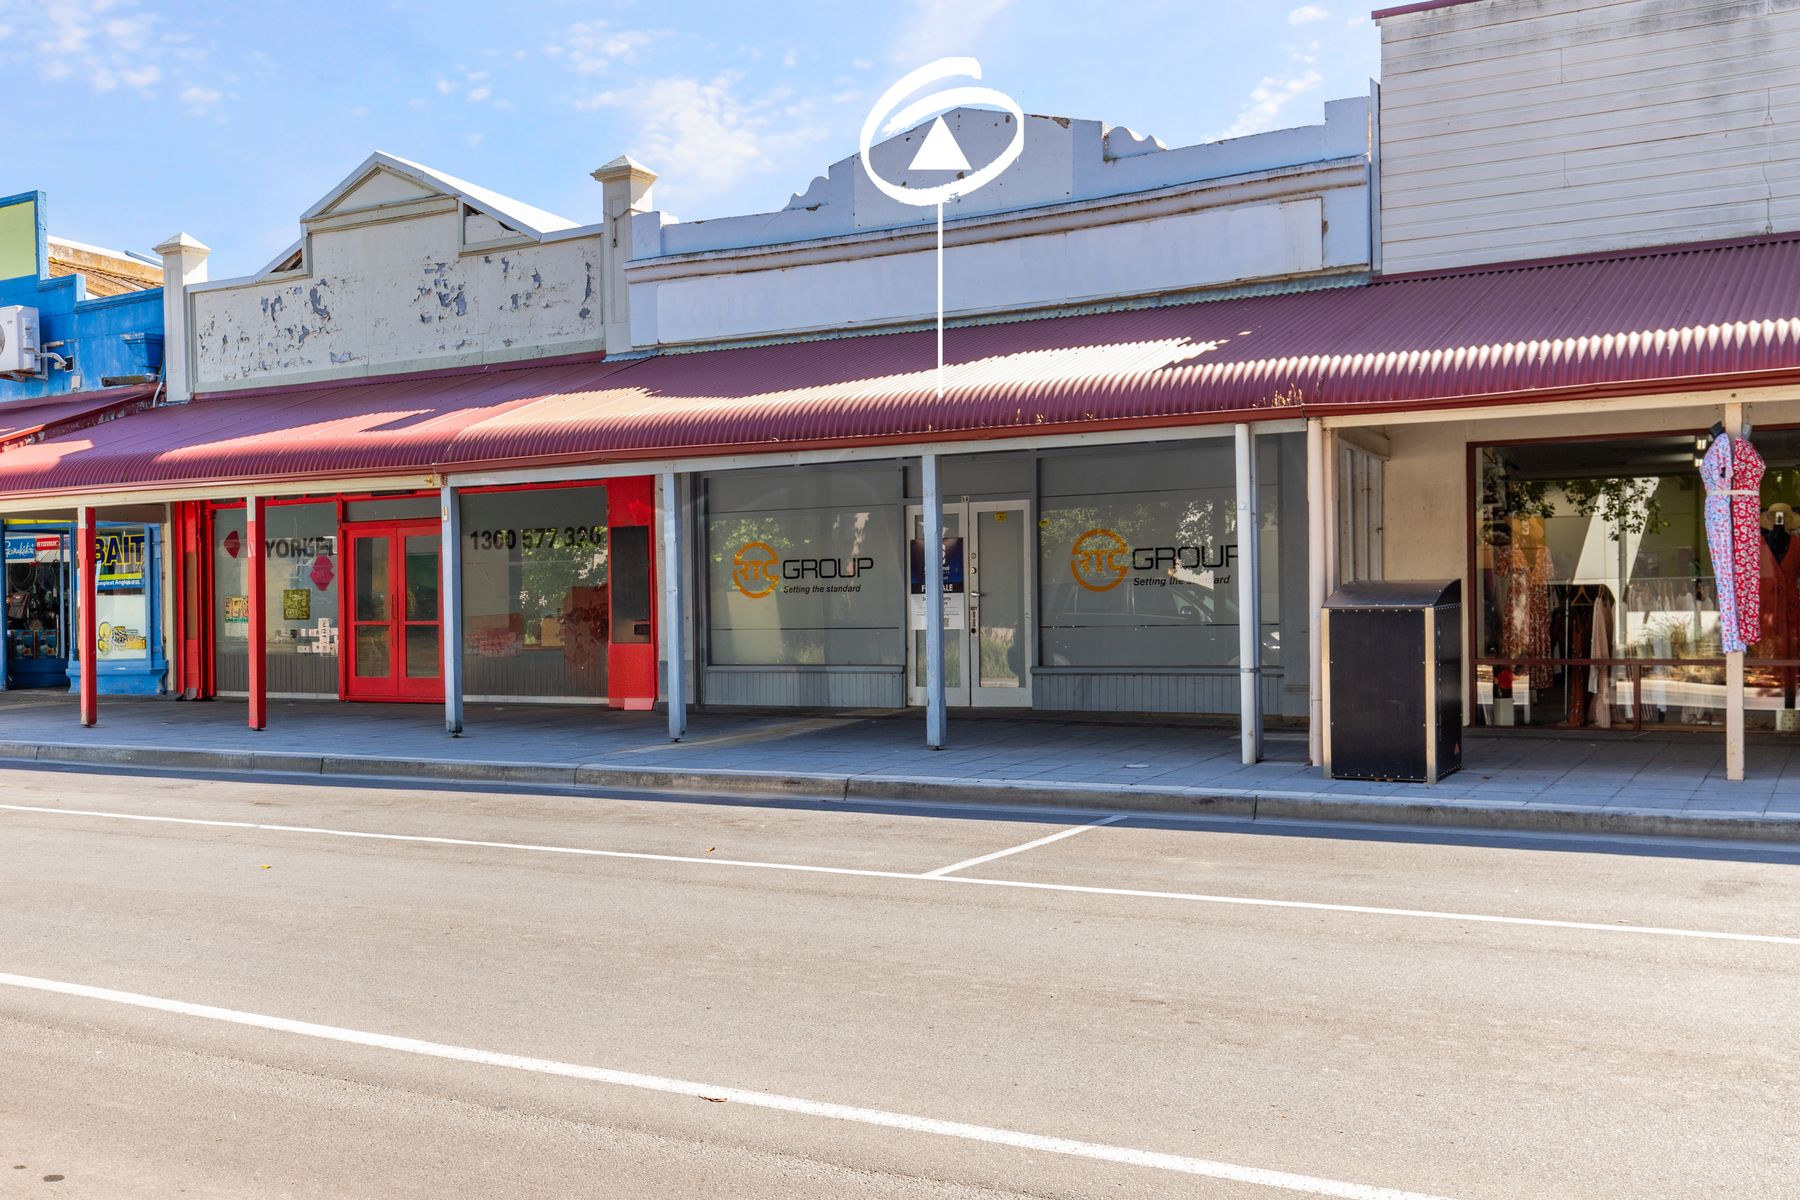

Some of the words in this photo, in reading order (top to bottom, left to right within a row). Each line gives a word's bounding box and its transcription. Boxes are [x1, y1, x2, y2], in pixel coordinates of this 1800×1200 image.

[95, 534, 145, 566] BAIT
[470, 529, 517, 550] 1300
[522, 528, 558, 549] 577
[782, 557, 874, 579] GROUP
[783, 585, 811, 595] Setting
[812, 585, 825, 593] the
[826, 584, 862, 593] standard
[1133, 577, 1167, 587] Setting
